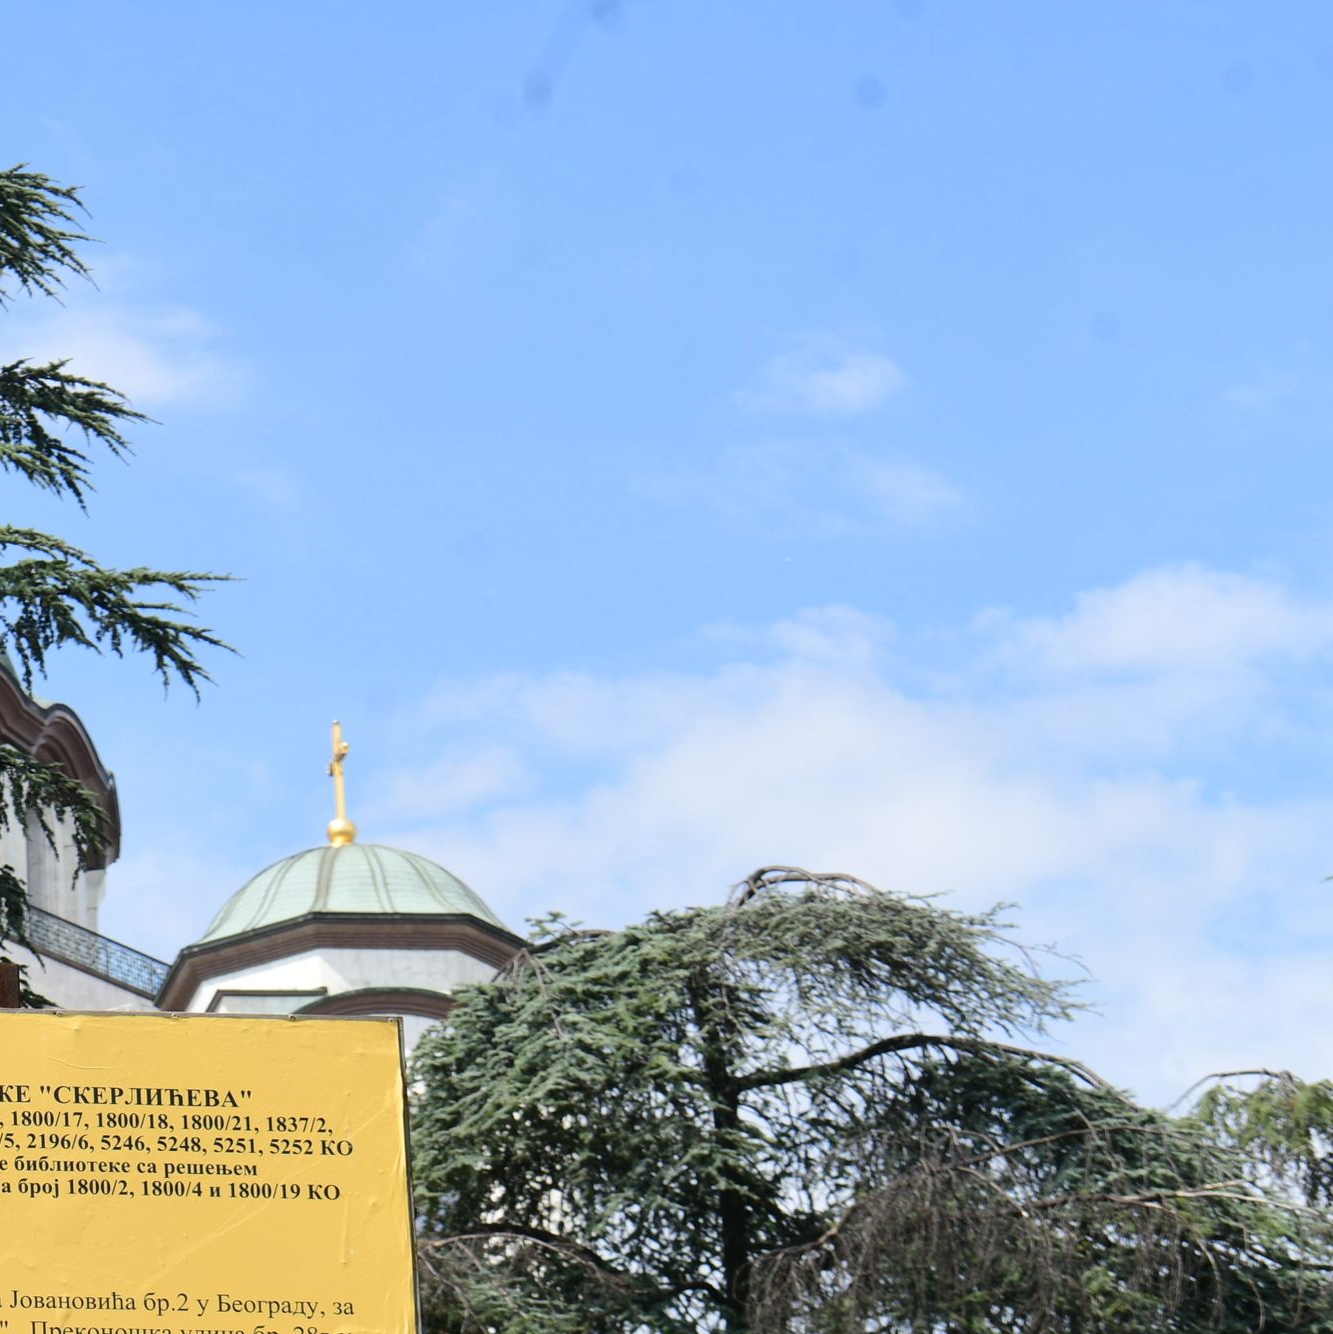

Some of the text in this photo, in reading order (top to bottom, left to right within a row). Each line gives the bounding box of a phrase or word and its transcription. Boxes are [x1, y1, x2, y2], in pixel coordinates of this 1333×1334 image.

[39, 1086, 252, 1109] "СКЕРЛИЋЕВА"
[10, 1111, 90, 1131] 1800/17,
[95, 1112, 175, 1134] 1800/18,
[180, 1114, 260, 1136] 1800/21,
[265, 1117, 334, 1137] 1837/2,
[25, 1133, 95, 1154] 2196/6,
[100, 1135, 152, 1155] 5246,
[156, 1136, 208, 1156] 5248,
[212, 1137, 264, 1158] 5251,
[268, 1139, 314, 1156] 5252
[318, 1140, 354, 1157] КО
[13, 1155, 131, 1174] библиотеке
[136, 1162, 158, 1175] са
[163, 1163, 258, 1179] решењем
[17, 1178, 60, 1199] број
[66, 1179, 135, 1200] 1800/2,
[141, 1181, 203, 1198] 1800/4
[208, 1187, 222, 1198] и
[228, 1183, 301, 1200] 1800/19
[307, 1184, 341, 1201] КО
[9, 1290, 137, 1311] Јовановића
[196, 1299, 210, 1318] у
[215, 1294, 326, 1320] Београду,
[332, 1302, 355, 1316] за
